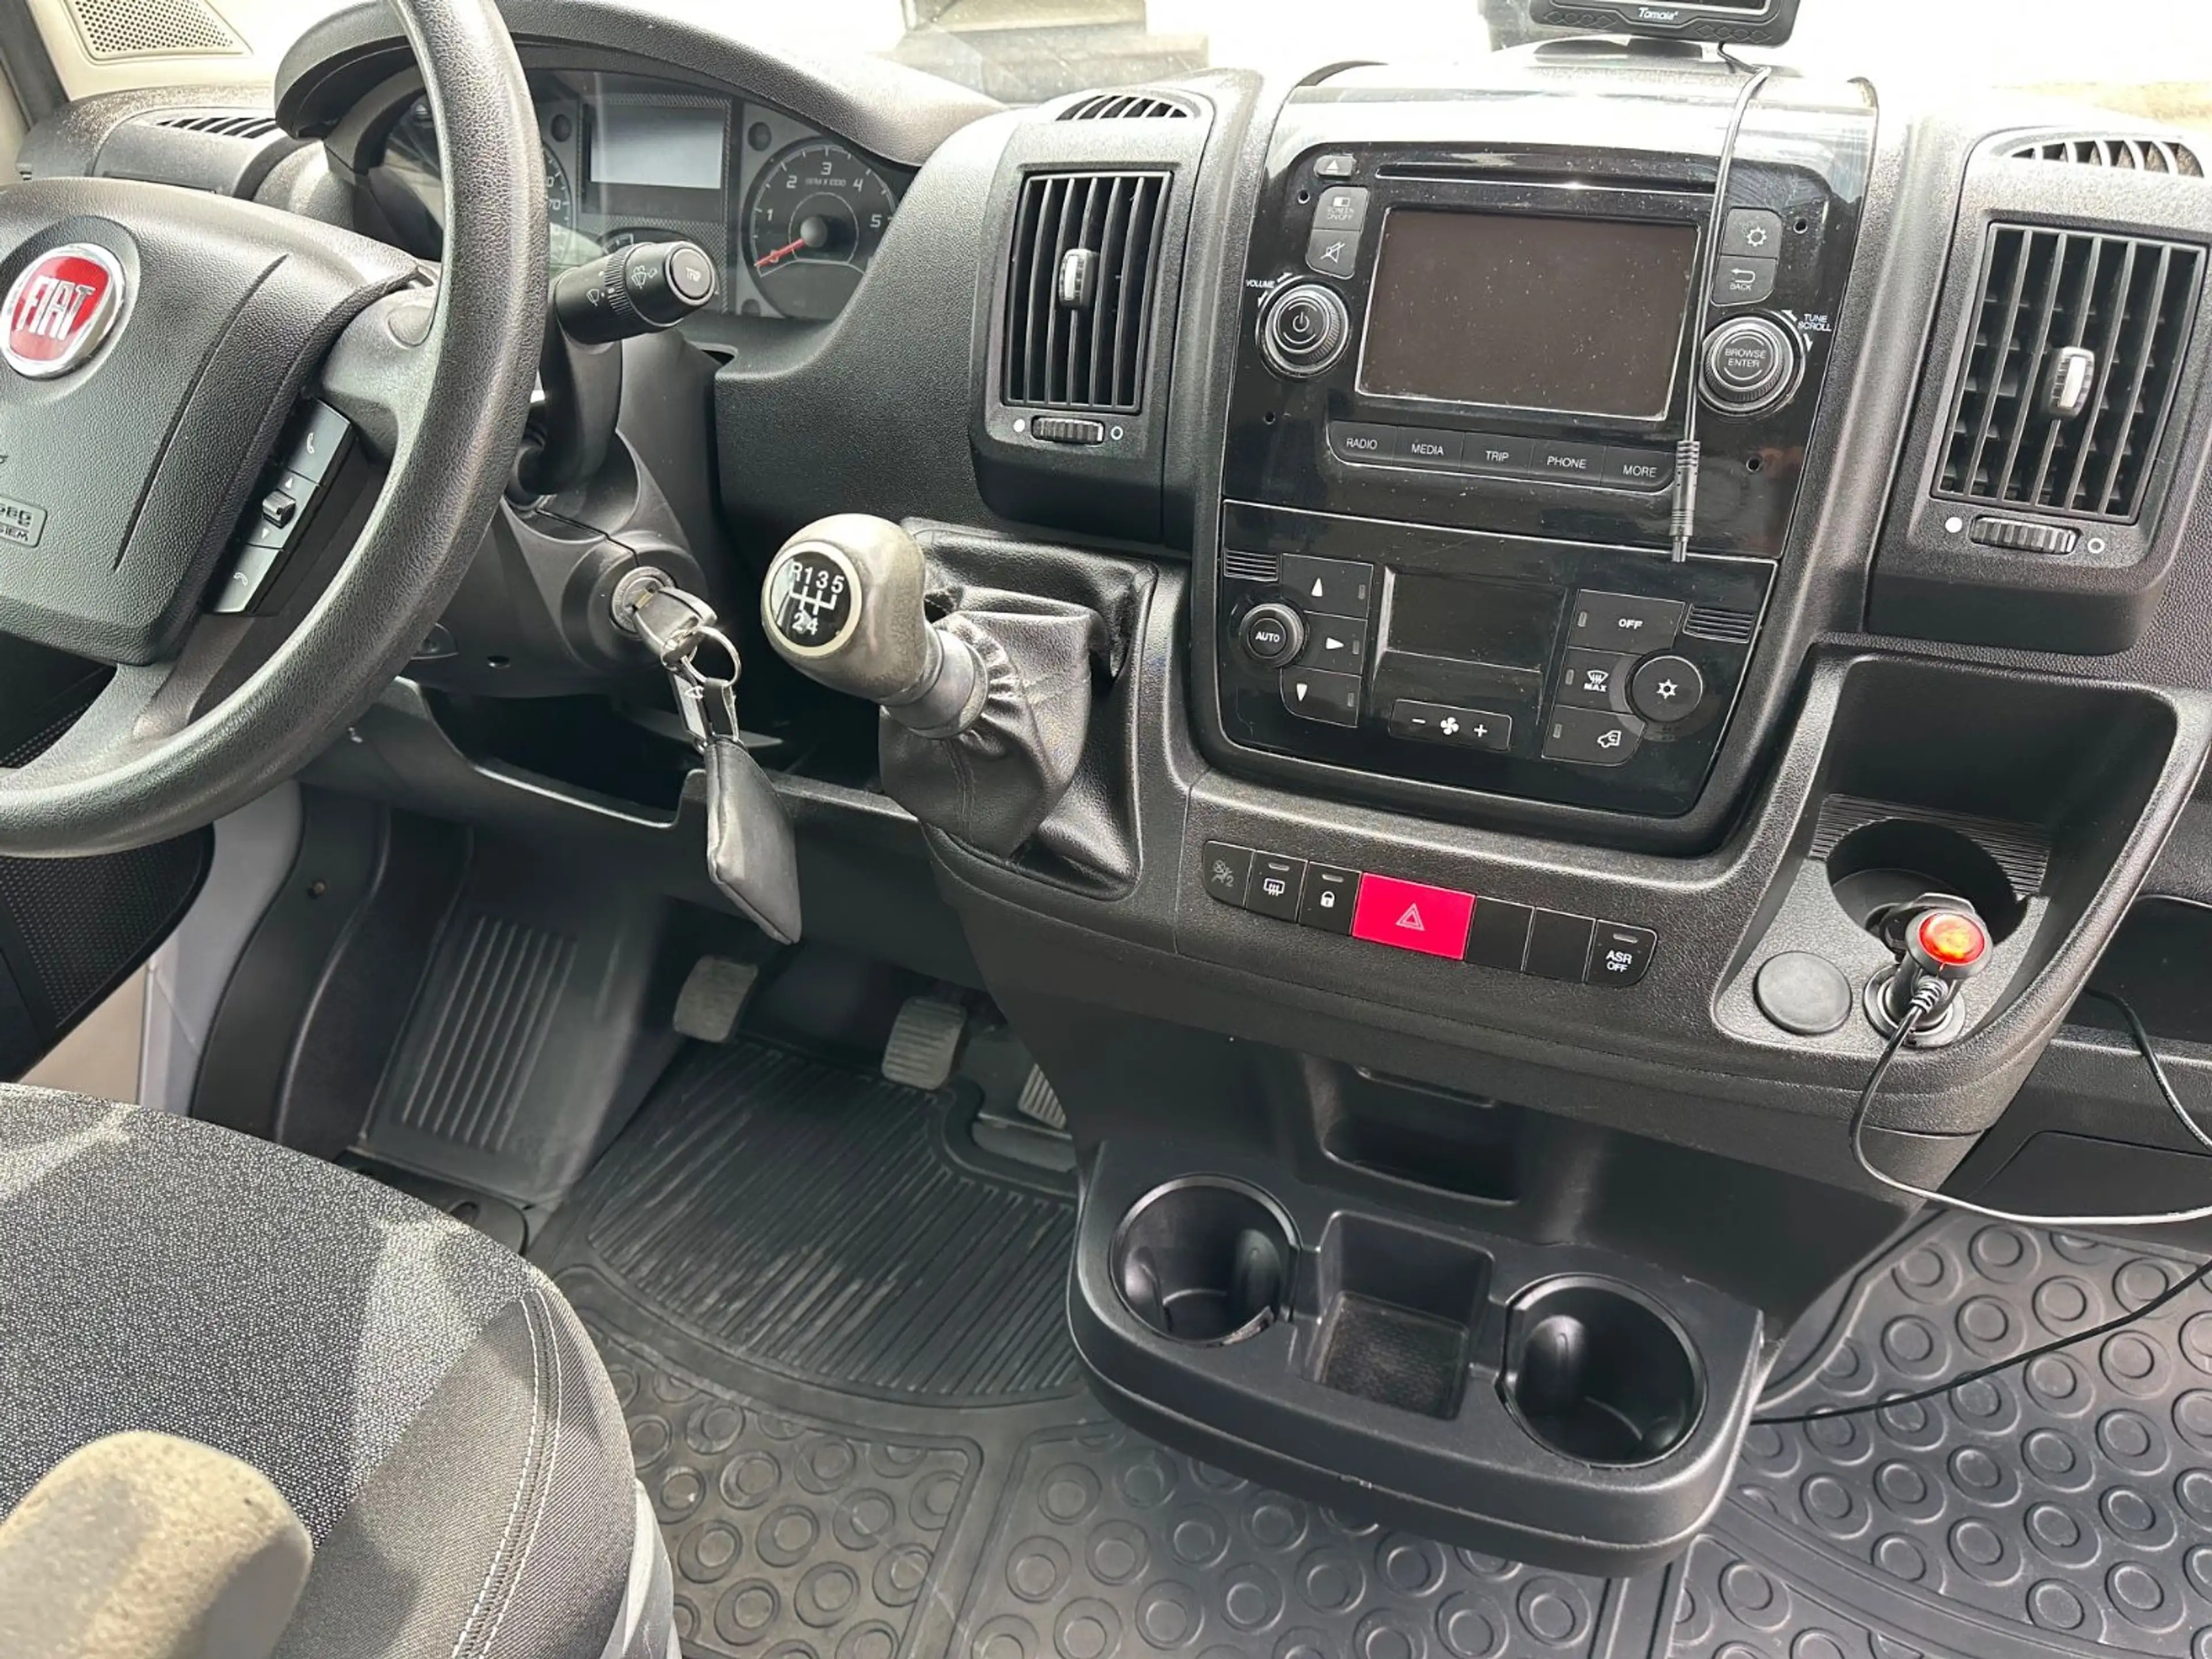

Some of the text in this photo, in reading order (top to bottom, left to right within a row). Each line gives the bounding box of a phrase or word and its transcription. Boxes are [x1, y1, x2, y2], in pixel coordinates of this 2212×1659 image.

[820, 162, 832, 175] 3
[786, 176, 797, 189] 2
[853, 179, 863, 192] 4
[767, 209, 774, 221] 1
[870, 214, 882, 228] 5
[1245, 279, 1275, 289] VOLUME
[1729, 283, 1752, 291] BACK
[16, 274, 97, 341] FIAT
[1804, 313, 1828, 323] TUNE
[1797, 321, 1832, 332] SCROLL
[1725, 348, 1767, 359] BROWSE
[1728, 358, 1760, 368] ENTER
[1346, 438, 1658, 478] RADIO MEDIA TRIP PHONE MORE
[805, 567, 813, 585] 1
[816, 570, 829, 589] 3
[831, 575, 845, 594] 5
[791, 612, 819, 635] 2 4
[1619, 618, 1643, 630] OFF
[1255, 631, 1280, 643] AUTO
[1584, 683, 1607, 692] MAX
[1605, 949, 1633, 965] ASR
[1607, 960, 1628, 972] OFF
